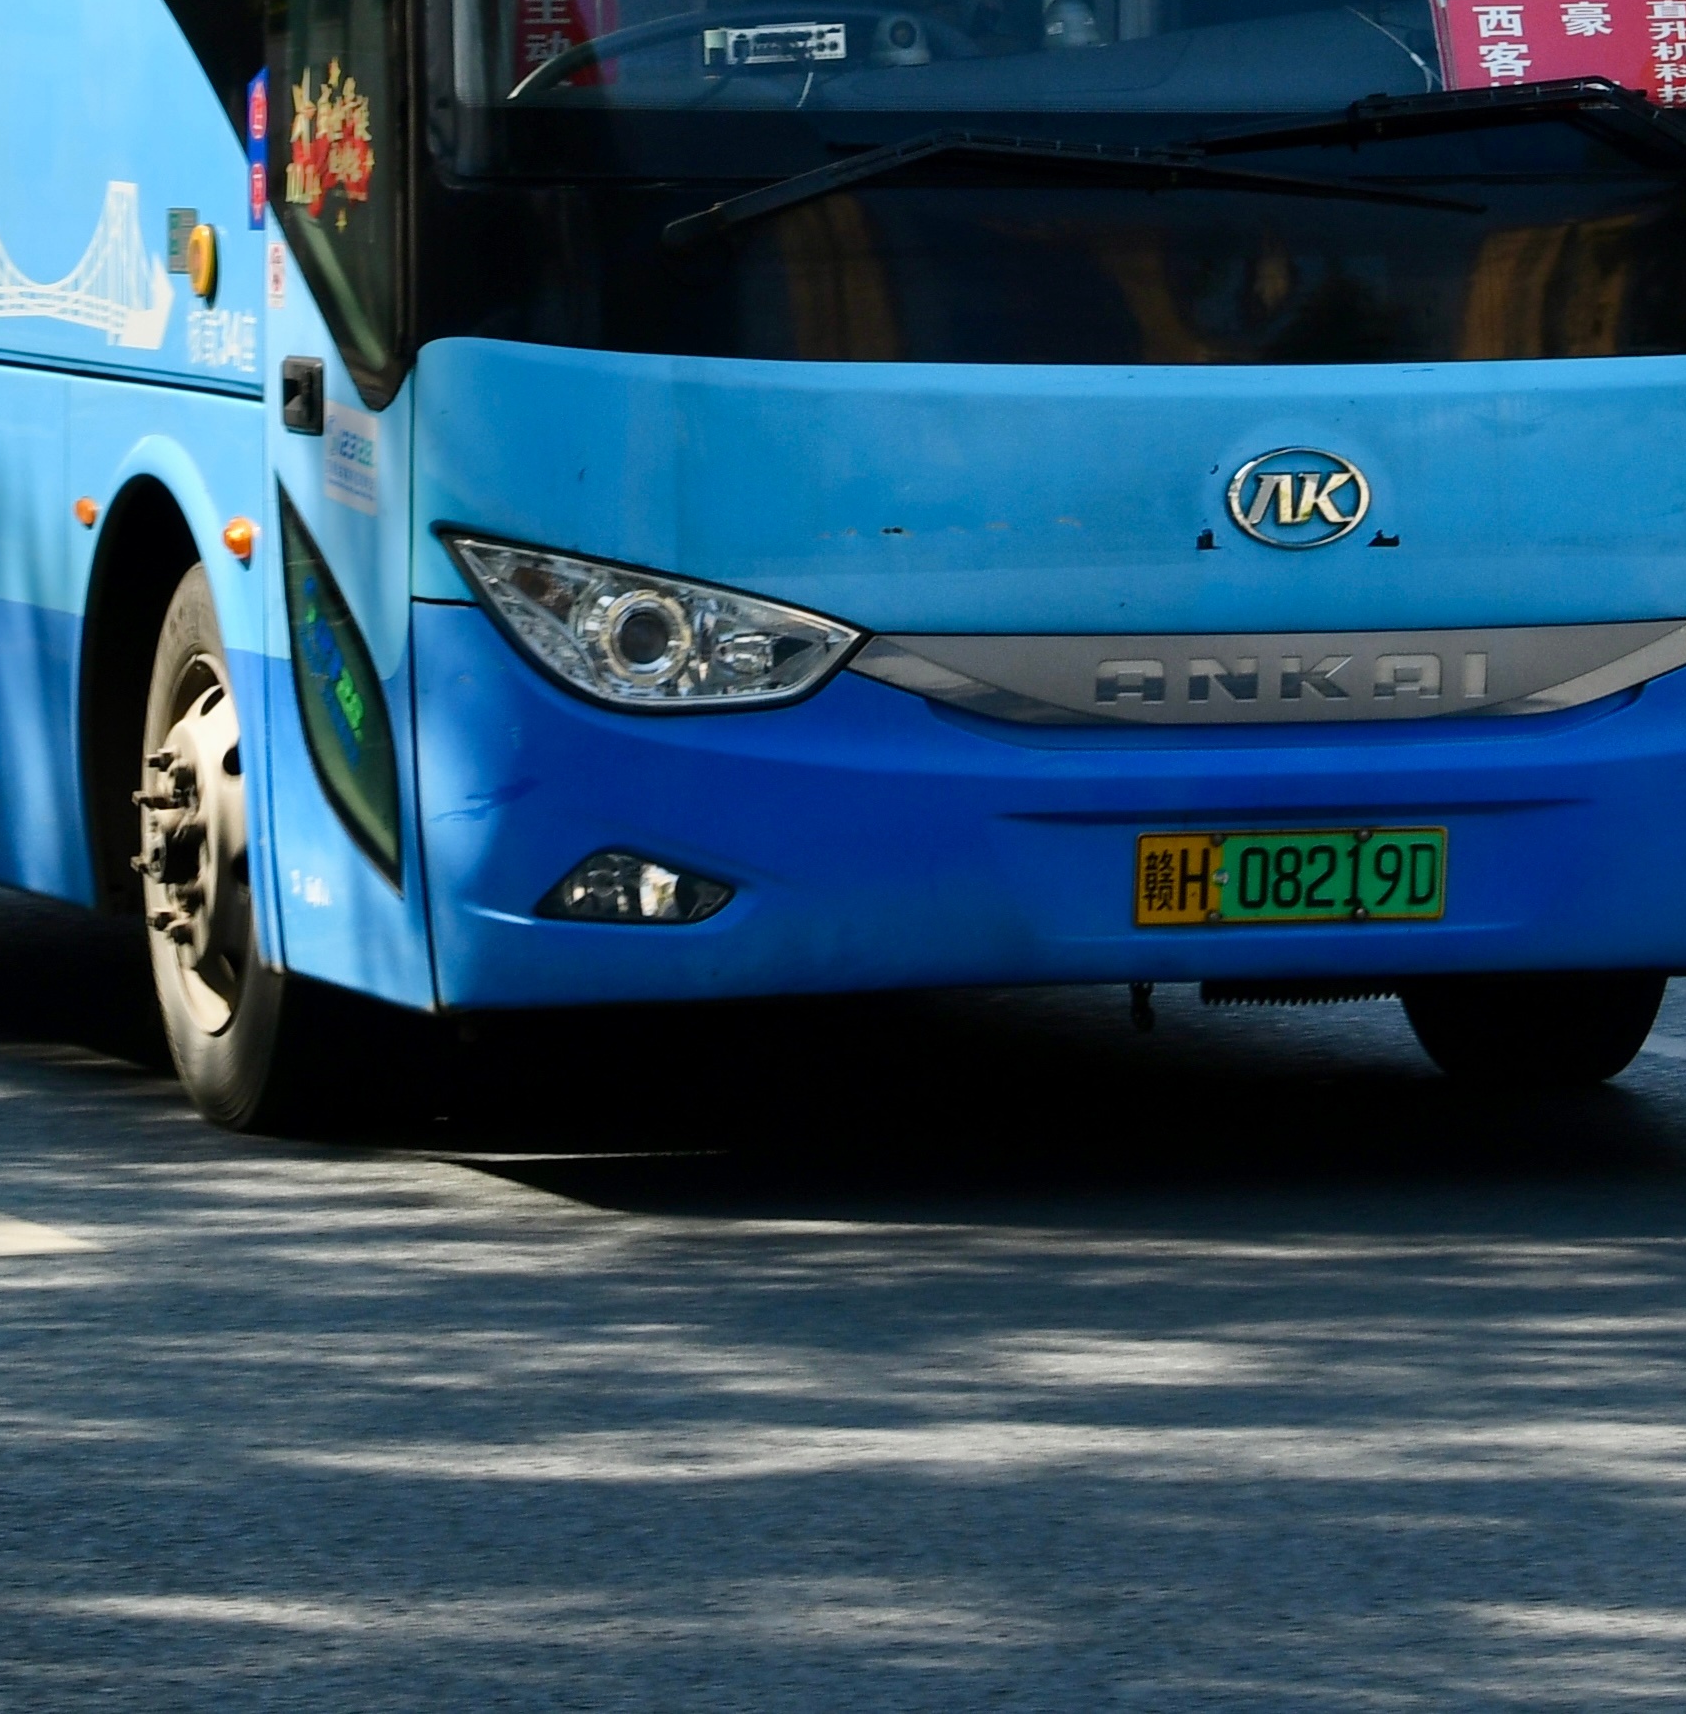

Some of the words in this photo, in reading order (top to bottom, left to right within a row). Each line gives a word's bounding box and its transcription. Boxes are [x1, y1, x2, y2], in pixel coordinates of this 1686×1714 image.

[1472, 4, 1532, 87] 西客
[1095, 651, 1488, 706] ANKAI
[1238, 842, 1437, 909] 08219D
